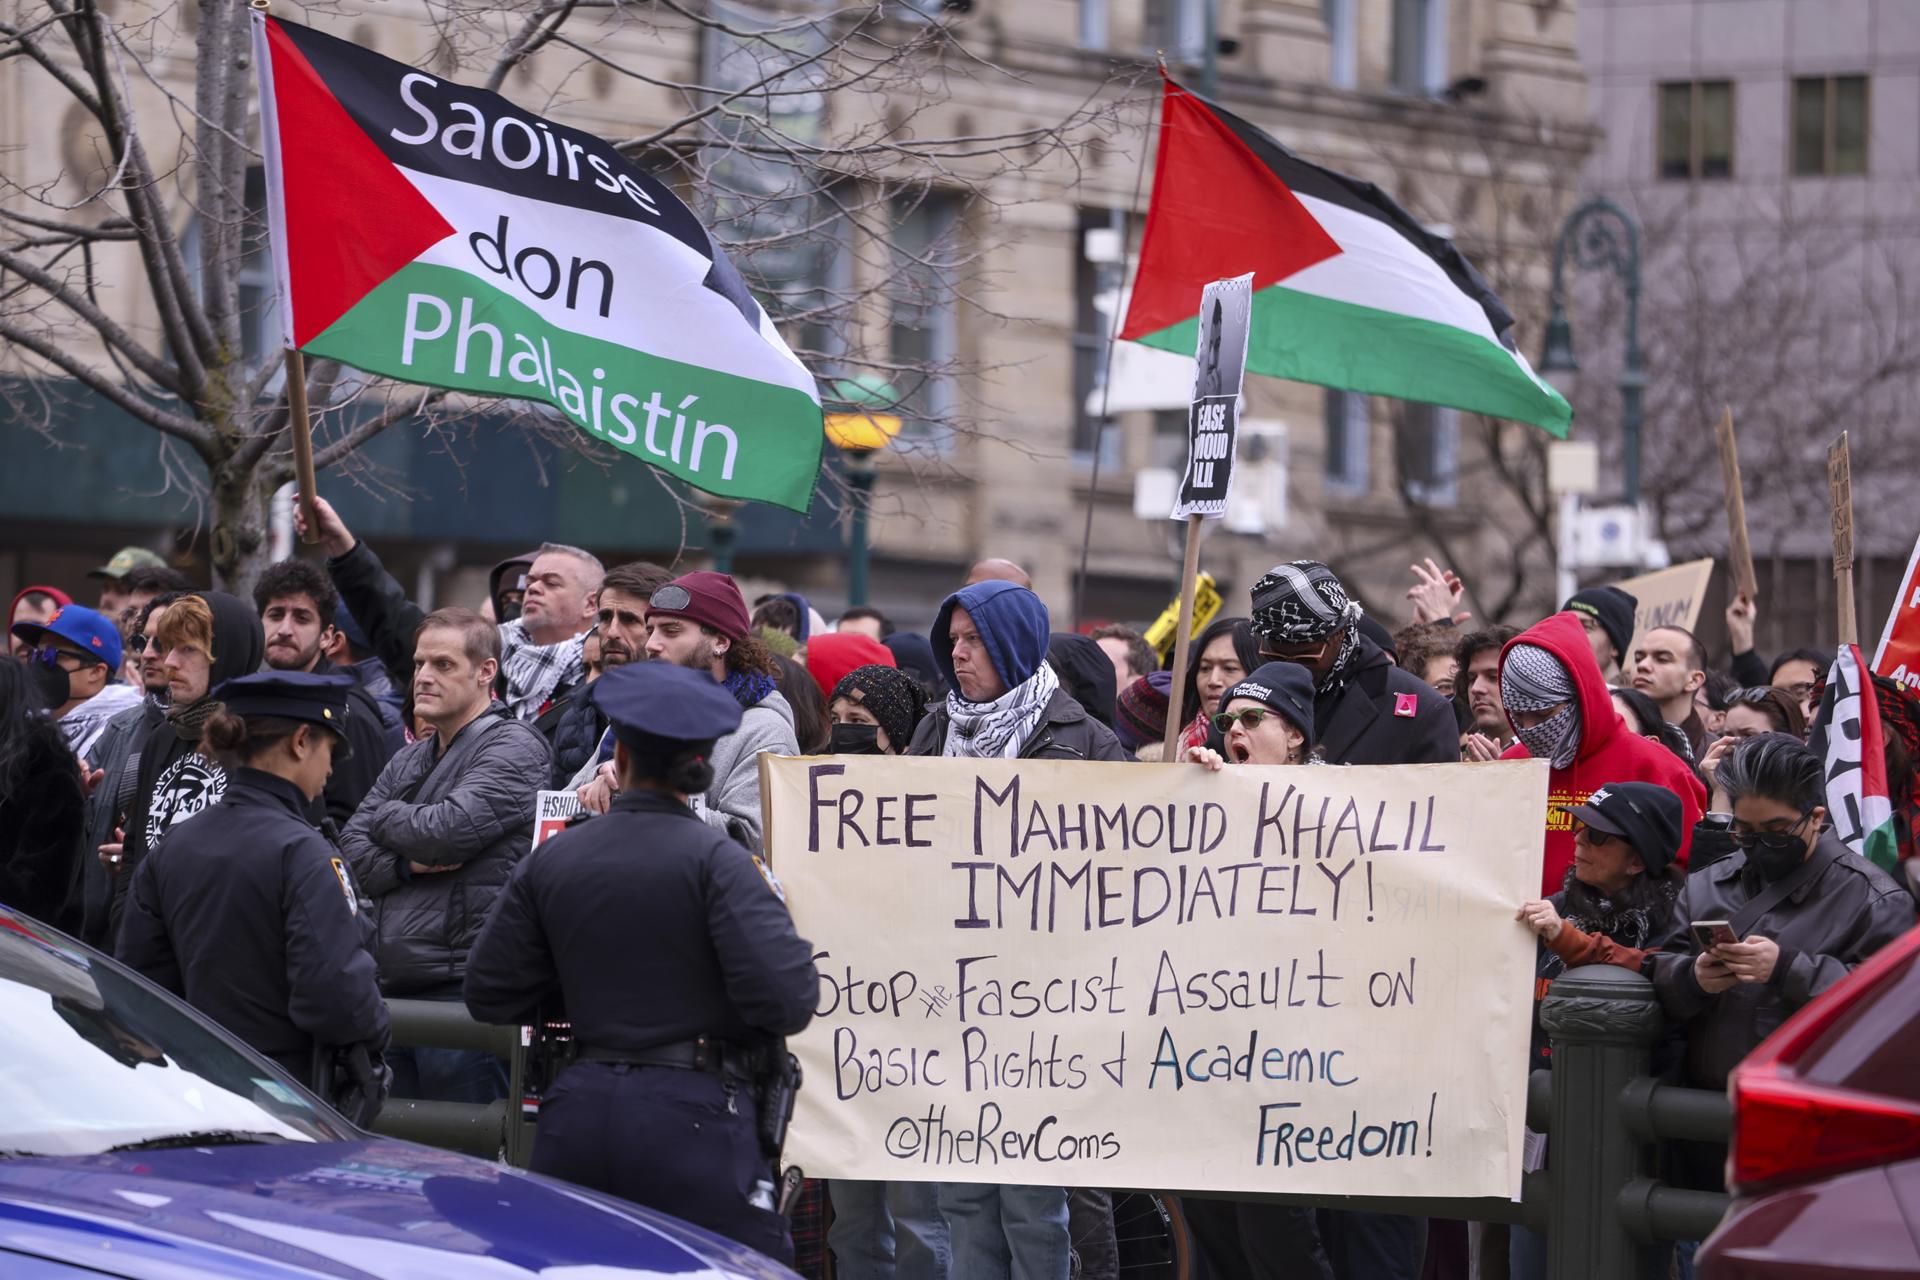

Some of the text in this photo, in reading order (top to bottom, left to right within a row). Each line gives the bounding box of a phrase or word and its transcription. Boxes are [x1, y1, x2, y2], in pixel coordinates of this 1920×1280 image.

[391, 73, 660, 216] Saoirse
[469, 215, 614, 318] don
[401, 293, 738, 480] Phalaistín
[808, 764, 1446, 859] FREE MAHMOUD KHALIL
[952, 860, 1374, 933] IMMEDIATELY!
[956, 955, 1126, 1022] Fascist
[1148, 949, 1344, 1017] Assault
[833, 1027, 946, 1100] Basic
[962, 1026, 1087, 1092] Rights
[1149, 1026, 1359, 1091] Academic
[885, 1101, 1121, 1165] @theRevComs
[1257, 1092, 1437, 1168] Freedom!
